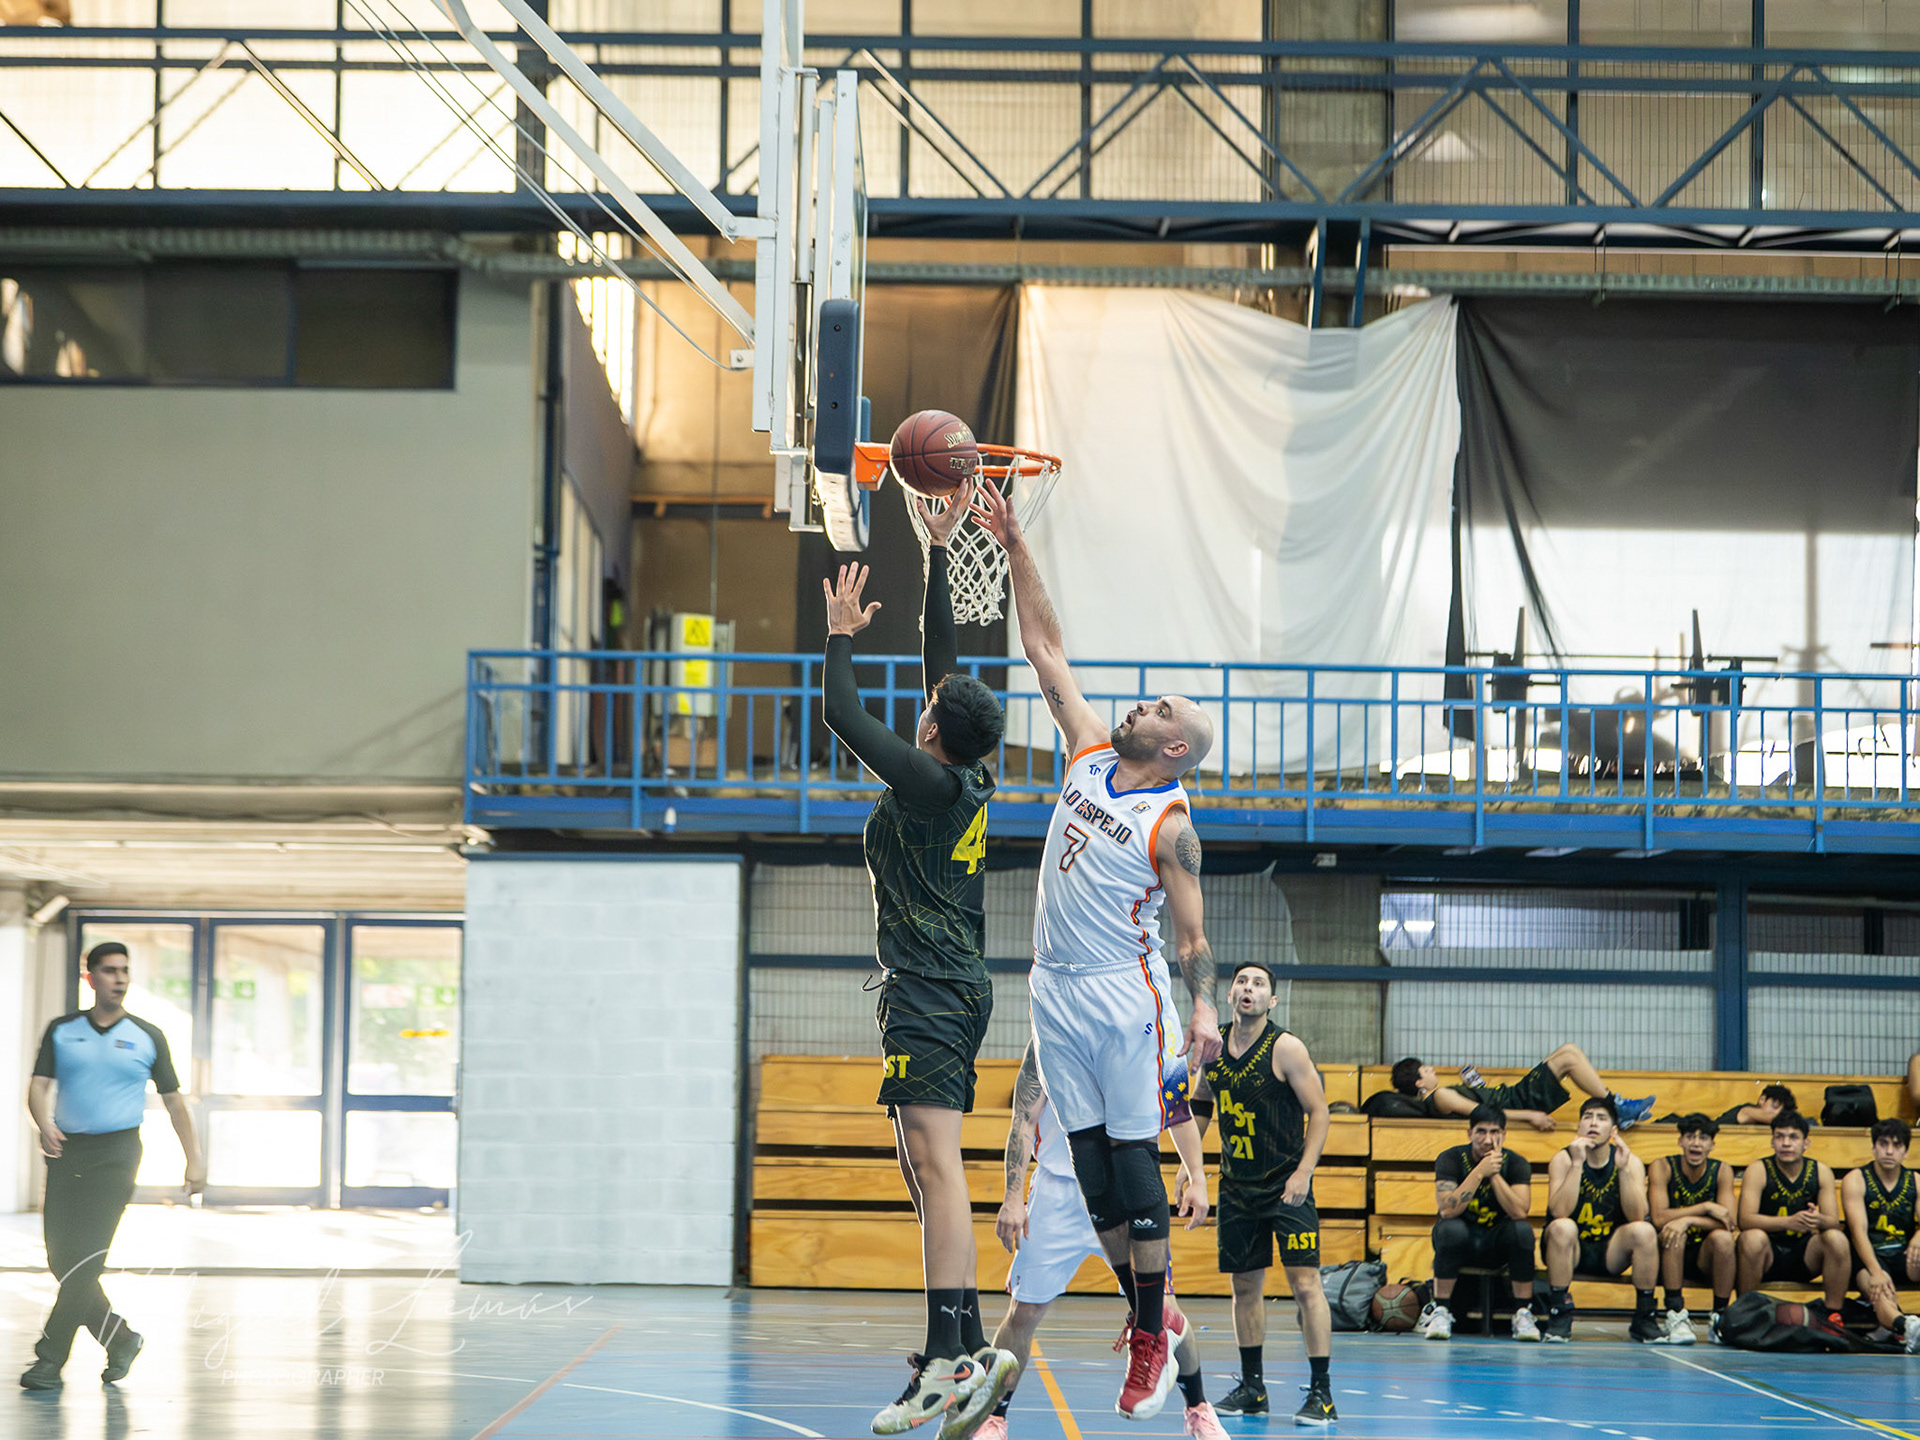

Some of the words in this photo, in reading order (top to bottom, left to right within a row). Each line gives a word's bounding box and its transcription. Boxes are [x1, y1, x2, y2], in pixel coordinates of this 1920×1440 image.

[1062, 782, 1082, 808] LO
[1073, 796, 1134, 847] ESPEJO
[1059, 822, 1091, 873] 7
[885, 1055, 910, 1079] ST
[1220, 1090, 1256, 1136] AST
[1230, 1135, 1254, 1160] 21
[1287, 1232, 1317, 1250] AST
